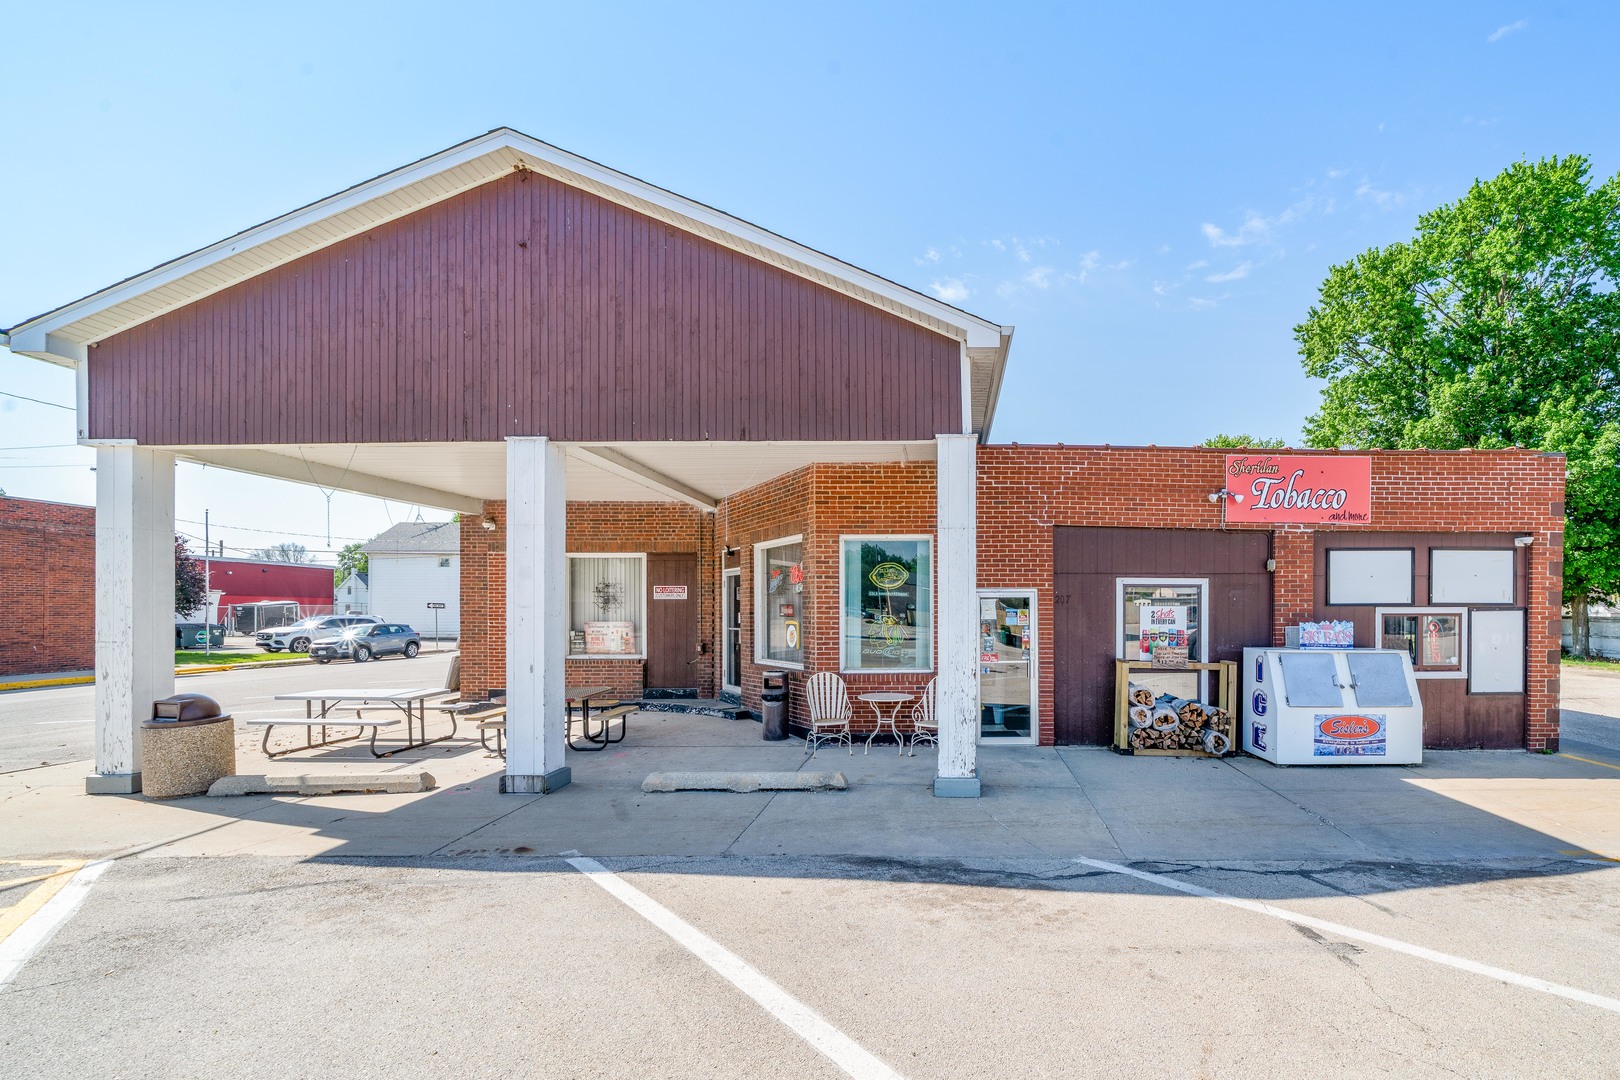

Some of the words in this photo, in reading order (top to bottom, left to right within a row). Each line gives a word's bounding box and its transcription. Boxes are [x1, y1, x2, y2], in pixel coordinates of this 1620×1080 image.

[1229, 457, 1279, 477] Sheridan
[1250, 469, 1347, 510] Tobacco
[1328, 510, 1347, 521] and
[1348, 511, 1369, 521] more
[1055, 595, 1071, 604] 207
[1156, 608, 1175, 619] Shots
[1302, 630, 1320, 642] BIG
[1323, 630, 1353, 644] BAGS
[1428, 621, 1441, 663] OPEN
[1252, 655, 1268, 752] ICE
[1330, 720, 1369, 734] Sisler's
[1335, 745, 1364, 755] ICE
